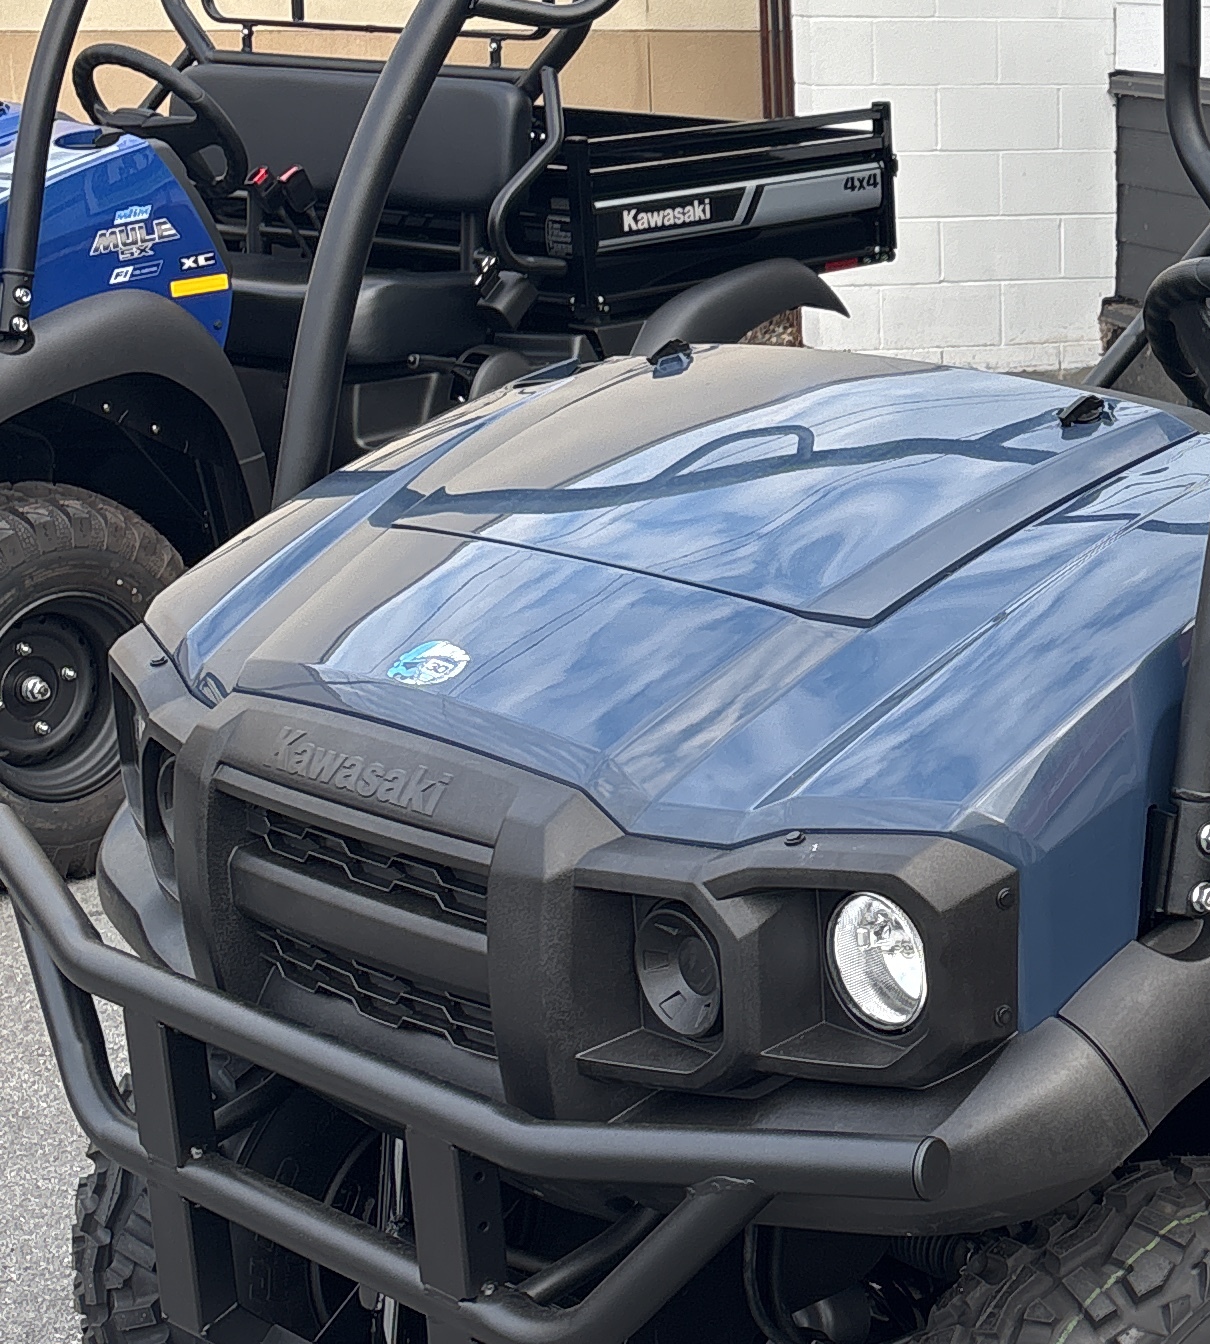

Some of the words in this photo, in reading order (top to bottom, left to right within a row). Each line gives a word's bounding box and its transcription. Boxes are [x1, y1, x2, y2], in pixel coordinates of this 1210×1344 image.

[843, 173, 880, 193] 4x4
[623, 197, 712, 233] Kawasaki
[90, 218, 180, 256] MULE
[119, 242, 155, 261] SX
[180, 252, 215, 270] XC
[264, 726, 454, 817] Kawasaki
